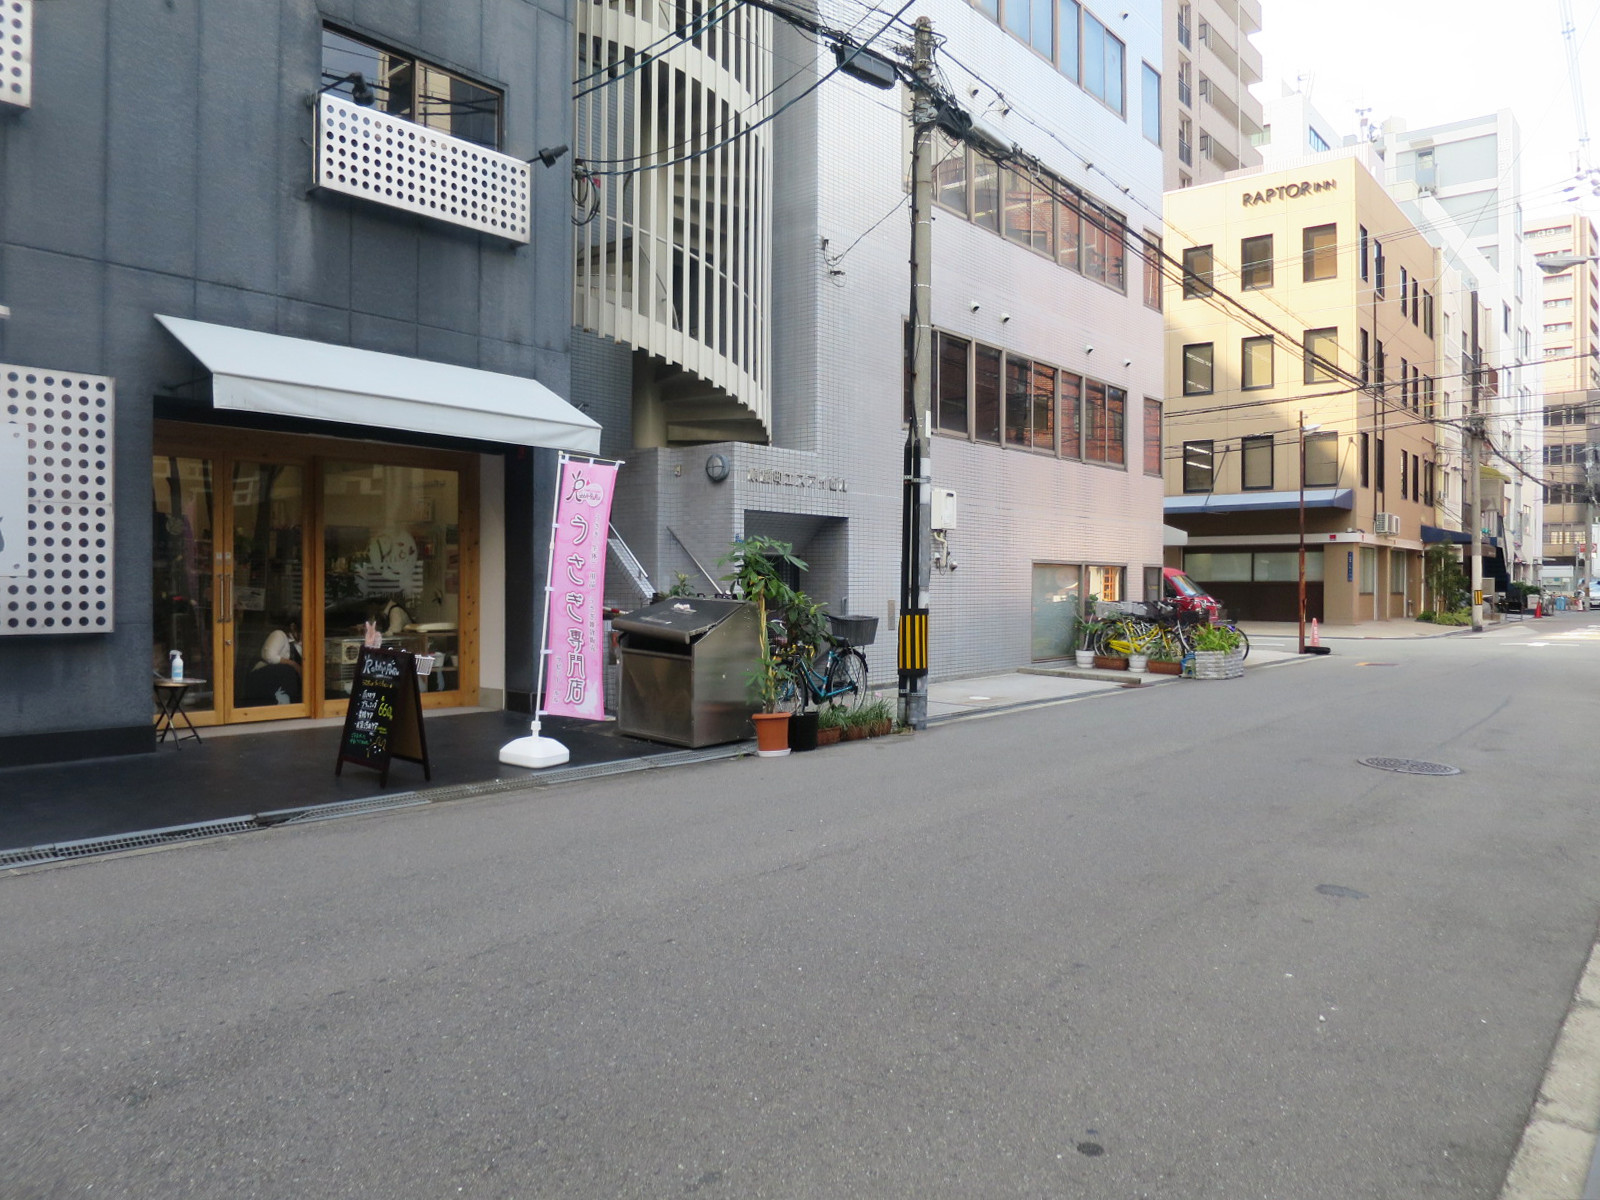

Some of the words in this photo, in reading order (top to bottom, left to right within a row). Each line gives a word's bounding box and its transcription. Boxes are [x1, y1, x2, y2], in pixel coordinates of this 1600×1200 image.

[1242, 181, 1313, 207] RAPTOR
[1313, 179, 1337, 193] INN
[564, 515, 588, 704] うさぎ専門店
